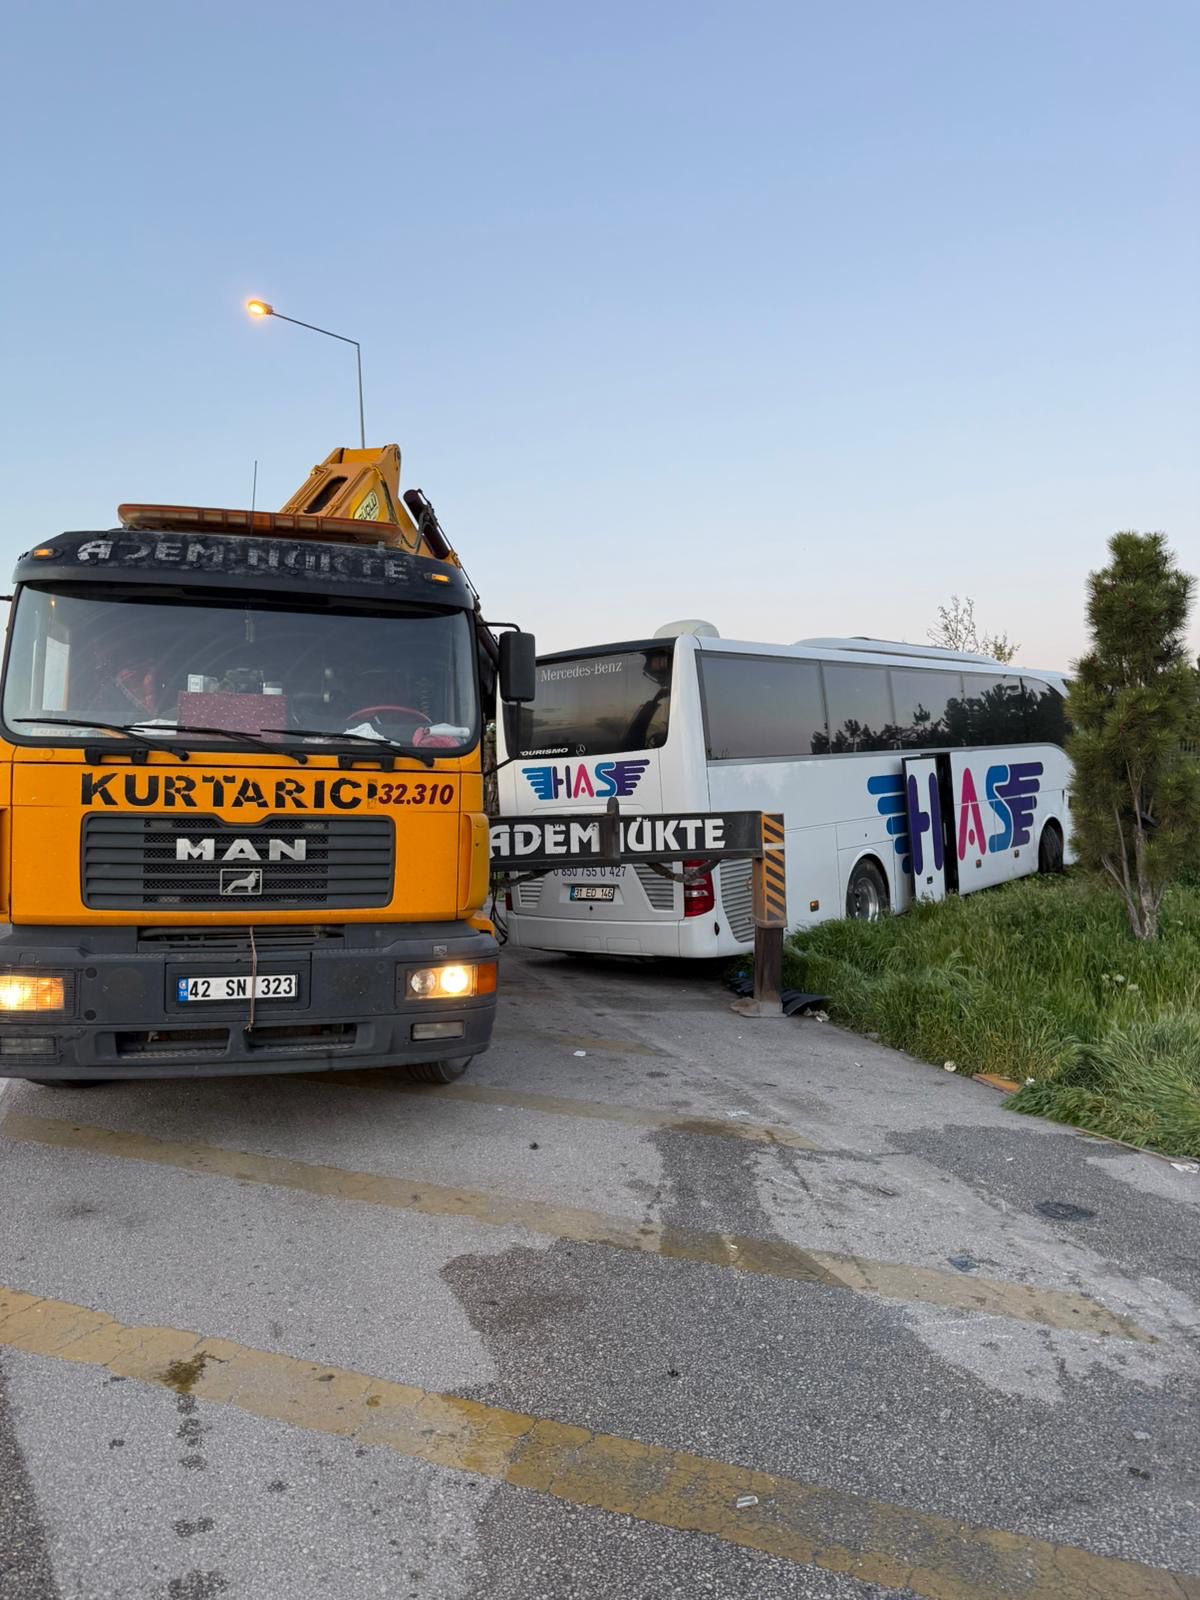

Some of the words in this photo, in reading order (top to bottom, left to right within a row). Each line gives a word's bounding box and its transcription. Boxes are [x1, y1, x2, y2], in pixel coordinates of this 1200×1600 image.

[77, 540, 225, 563] ADEM
[540, 662, 623, 682] Mercedes-Benz
[378, 783, 454, 805] 32.310
[176, 838, 306, 861] MAN
[490, 822, 600, 858] ADEM
[609, 866, 627, 877] 427
[189, 980, 211, 998] 42
[226, 979, 247, 997] SN
[261, 977, 293, 996] 323
